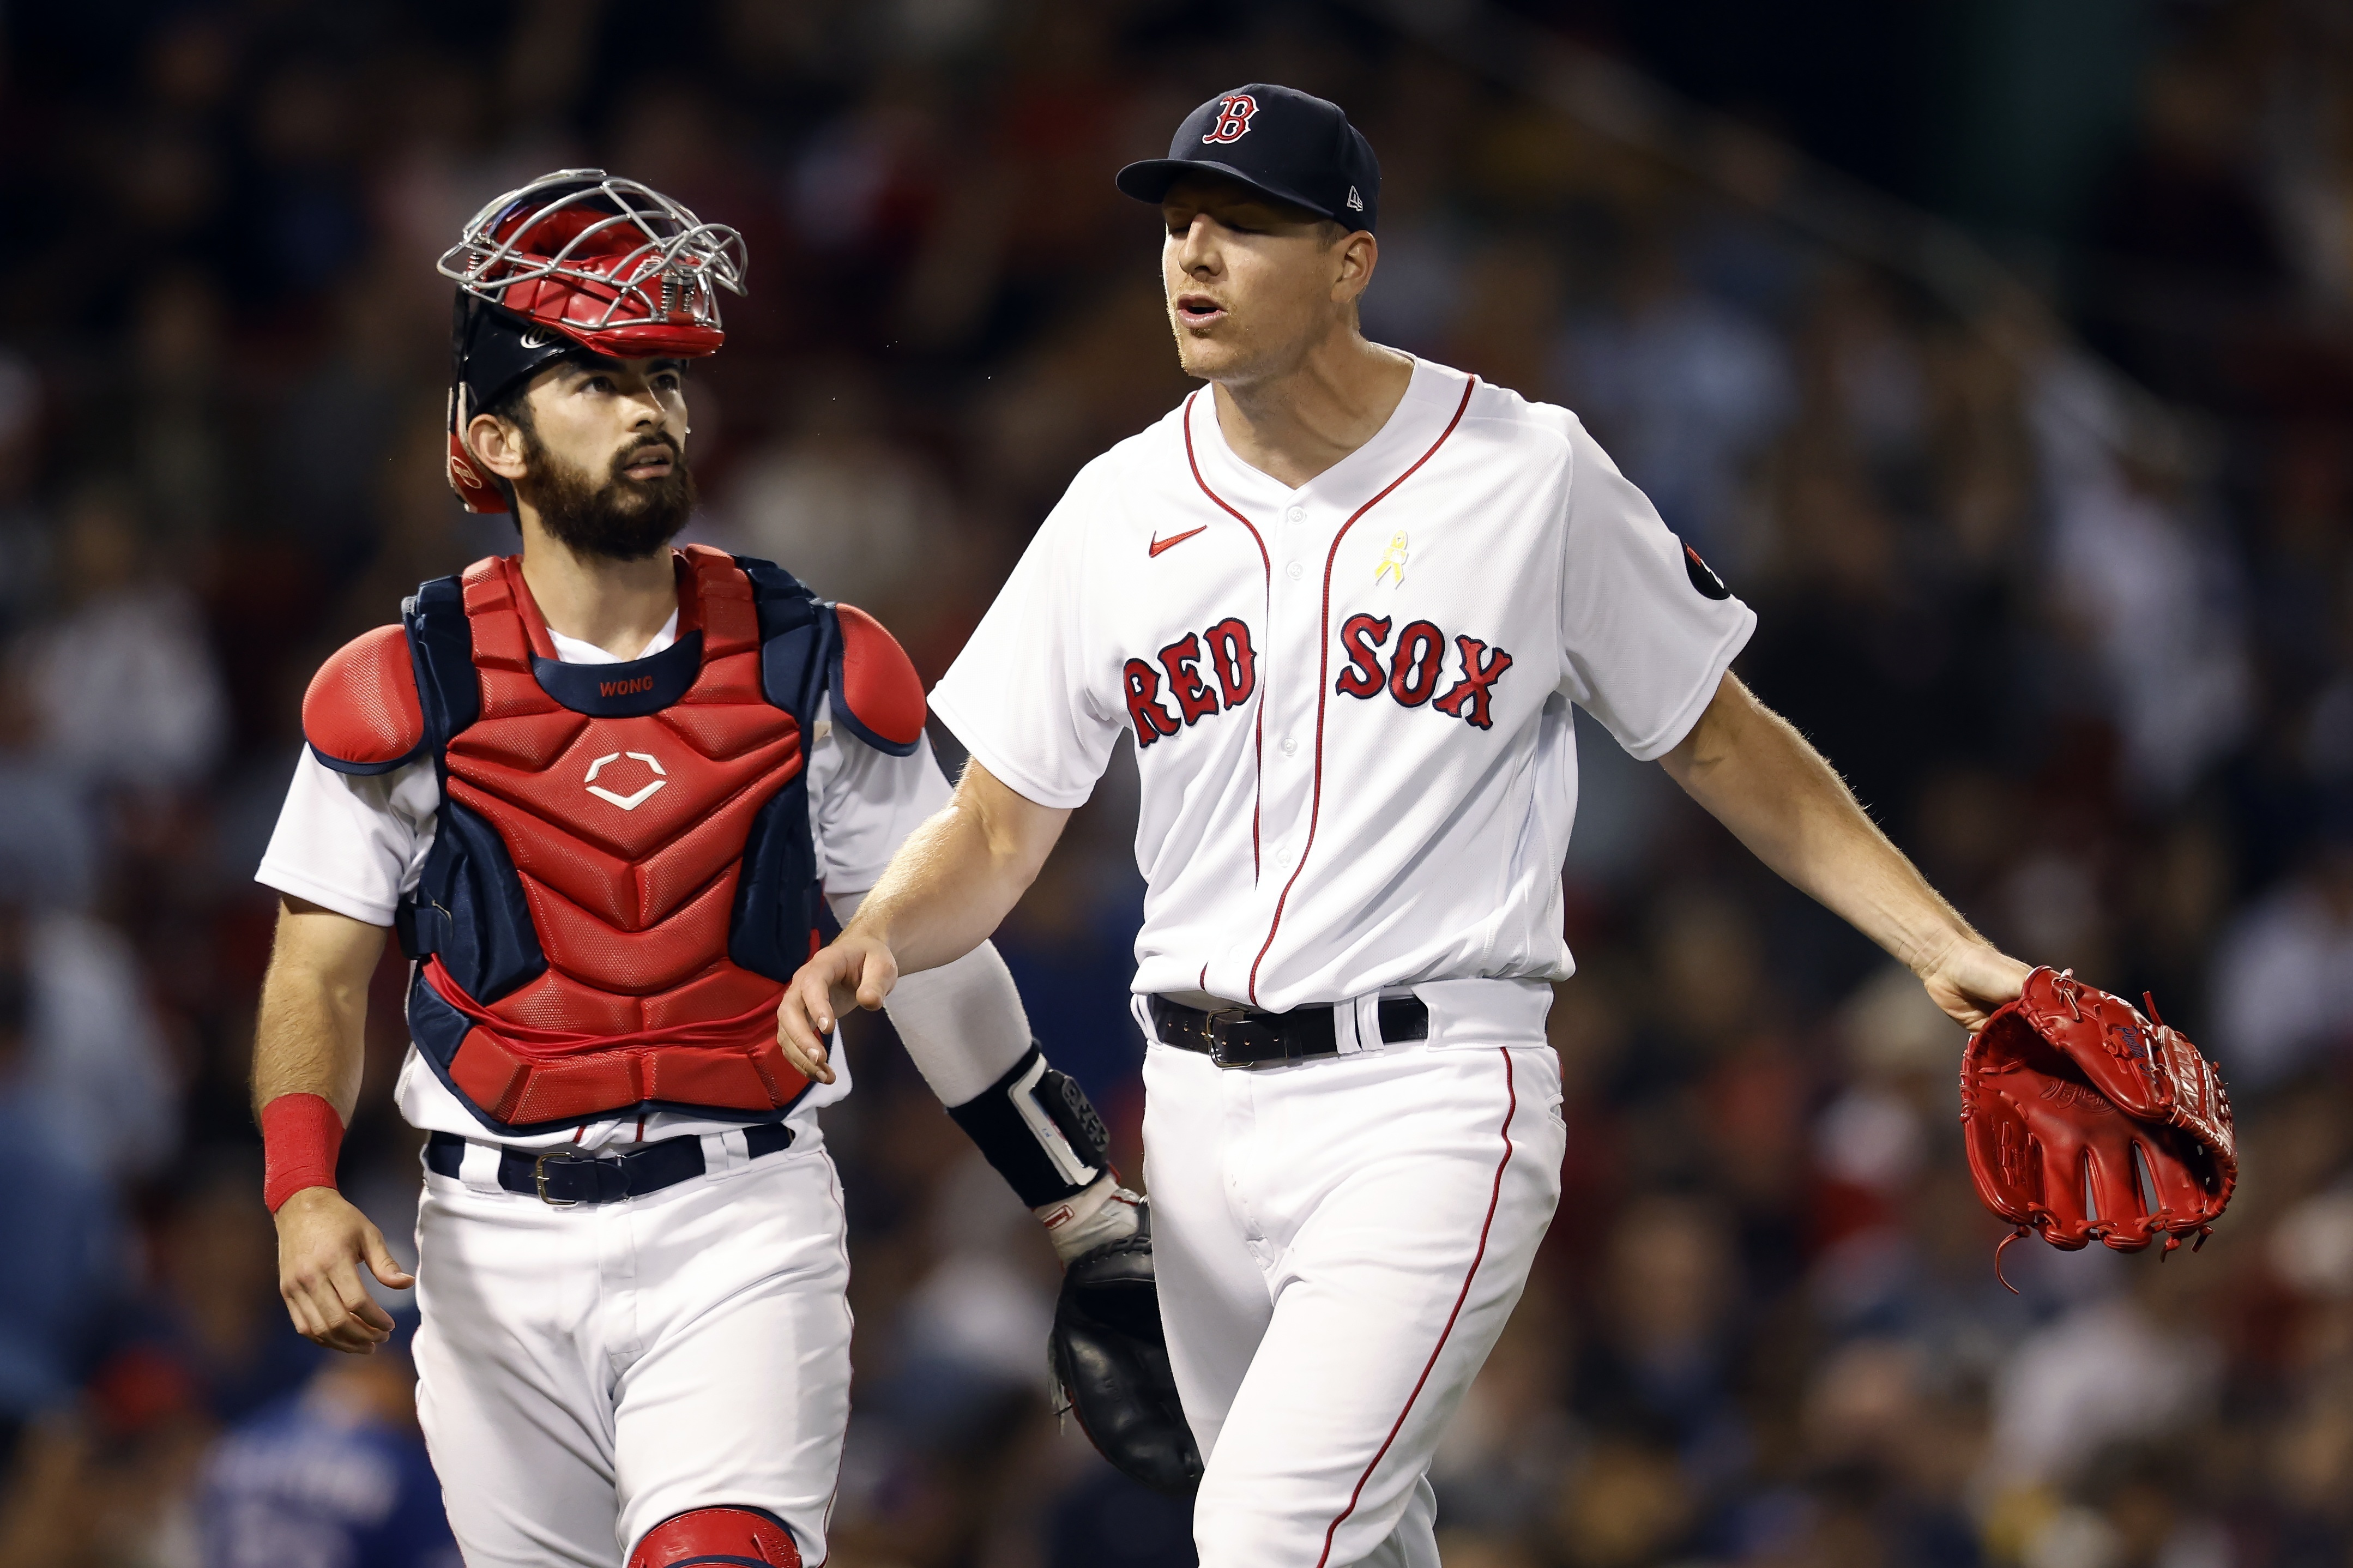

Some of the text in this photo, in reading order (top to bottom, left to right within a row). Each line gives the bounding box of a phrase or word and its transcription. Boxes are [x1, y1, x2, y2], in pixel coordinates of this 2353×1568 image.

[1202, 94, 1260, 144] B
[600, 676, 654, 697] WONG
[1123, 613, 1513, 749] RED SOX
